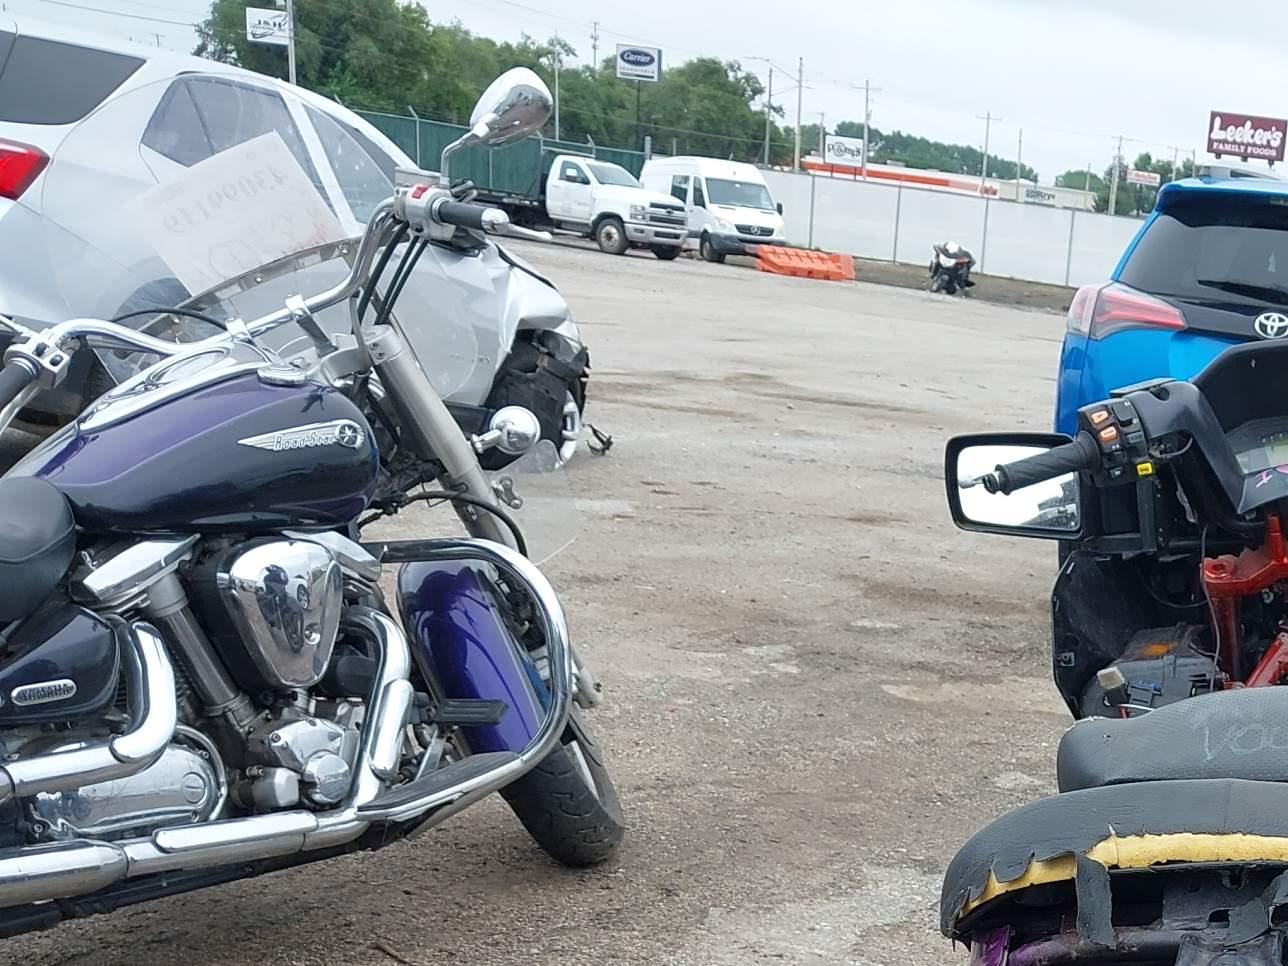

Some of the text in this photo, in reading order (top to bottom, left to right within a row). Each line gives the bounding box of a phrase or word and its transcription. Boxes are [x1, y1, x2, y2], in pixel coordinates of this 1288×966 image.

[1210, 116, 1283, 148] Leeker's
[1212, 142, 1277, 156] FAMILY FOODS
